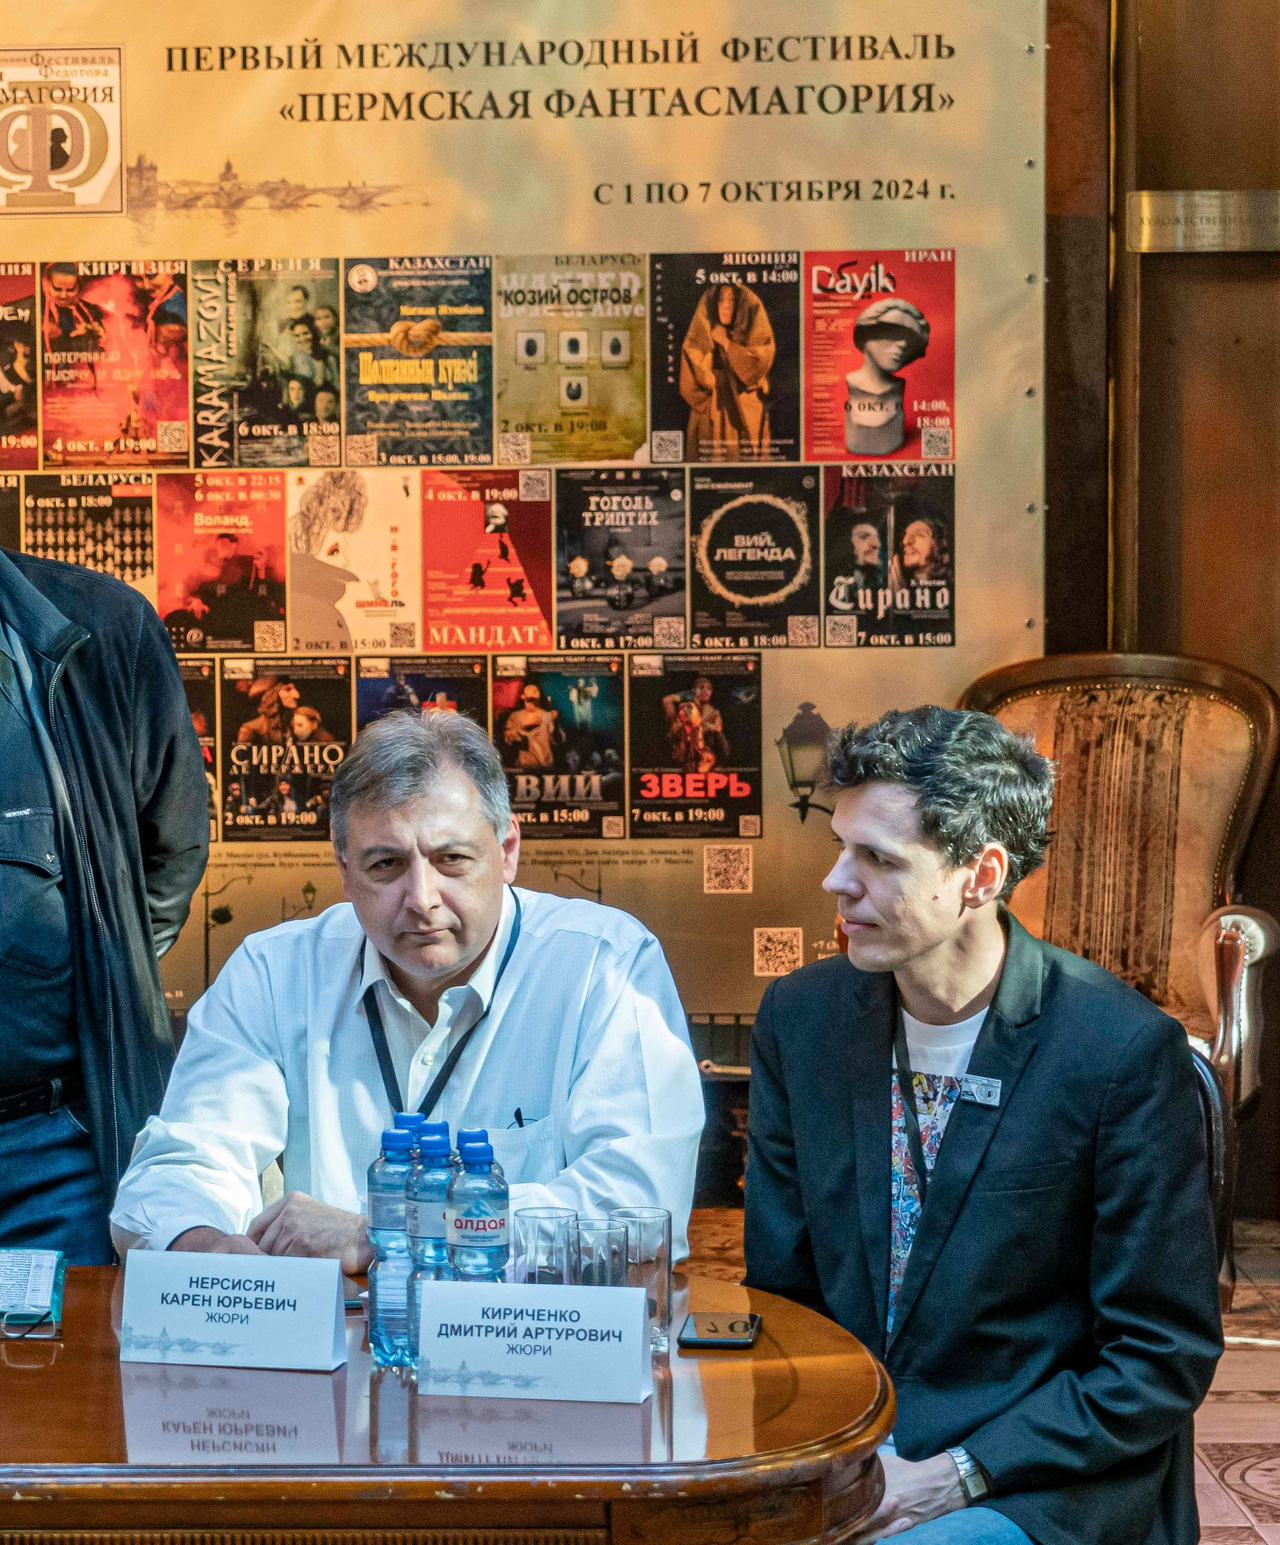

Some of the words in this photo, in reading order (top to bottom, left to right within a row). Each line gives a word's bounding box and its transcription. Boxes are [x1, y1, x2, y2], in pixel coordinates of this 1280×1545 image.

[165, 38, 323, 72] ПЕРВЫЙ
[336, 32, 700, 73] МЕЖДУНАРОДНЫЙ
[720, 33, 956, 64] ФЕСТИВАЛЬ
[279, 88, 532, 122] «ПЕРМСКАЯ
[544, 83, 955, 118] ФАНТАСМАГОРИЯ»
[594, 182, 613, 205] С
[624, 183, 634, 204] 1
[645, 182, 689, 203] ПО
[698, 182, 711, 203] 7
[720, 180, 861, 203] ОКТЯБРЯ
[871, 179, 930, 201] 2024
[388, 257, 491, 270] КАЗАХСТАН
[554, 254, 642, 266] БЕЛАРУСЬ
[722, 252, 798, 266] ЯПОНИЯ
[904, 249, 953, 263] ИРАН
[78, 260, 186, 276] КИРГИЗИЯ
[218, 258, 322, 273] СЕРБИЯ
[695, 269, 707, 285] 5
[709, 272, 743, 284] окт.
[746, 273, 756, 284] в
[762, 269, 798, 284] 14:00
[238, 421, 249, 437] 6
[251, 424, 284, 436] окт.
[288, 424, 299, 436] в
[302, 421, 340, 437] 18:00
[500, 420, 510, 434] 2
[515, 422, 548, 434] окт.
[554, 422, 563, 433] в
[569, 419, 607, 434] 19:00
[916, 416, 951, 429] 18:00
[0, 434, 38, 450] 19:00
[52, 437, 64, 453] 4
[66, 440, 101, 452] окт.
[119, 437, 157, 453] 19:00
[378, 452, 388, 465] 3
[841, 463, 954, 478] КАЗАХСТАН
[60, 473, 153, 487] БЕЛАРУСЬ
[194, 473, 204, 488] 5
[24, 494, 35, 509] 6
[81, 495, 113, 508] 18:00
[194, 488, 205, 503] 6
[424, 488, 435, 501] 4
[437, 490, 468, 501] окт.
[484, 488, 519, 500] 19:00
[589, 495, 655, 511] ГОГОЛЬ
[581, 510, 659, 527] ТРИПТИХ
[713, 547, 796, 562] ЛЕГЕНДА
[828, 576, 951, 620] Сирано
[293, 639, 301, 651] 2
[353, 638, 387, 650] 15:00
[429, 626, 539, 648] МАНДАТ
[559, 636, 567, 649] 1
[570, 638, 602, 649] окт.
[619, 636, 653, 649] 17:00
[692, 634, 702, 648] 5
[753, 635, 787, 648] 18:00
[857, 631, 867, 646] 7
[870, 634, 901, 646] окт.
[918, 631, 952, 646] 15:00
[230, 744, 345, 767] СИРАНО
[514, 770, 604, 803] ВИЙ
[640, 773, 752, 799] ЗВЕРЬ
[224, 811, 234, 826] 2
[235, 815, 266, 826] окт.
[280, 811, 318, 826] 19:00
[553, 809, 590, 823] 15:00
[632, 808, 640, 823] 7
[643, 812, 672, 823] окт.
[675, 812, 684, 823] в
[687, 808, 726, 823] 19:00
[189, 1276, 276, 1293] НЕРСИСЯН
[160, 1292, 212, 1308] КАРЕН
[217, 1295, 297, 1312] ЮРЬЕВИЧ
[205, 1311, 250, 1325] ЖЮРИ
[481, 1307, 581, 1324] КИРИЧЕНКО
[437, 1322, 518, 1340] ДМИТРИЙ
[522, 1325, 623, 1343] АРТУРОВИЧ
[506, 1343, 553, 1357] ЖЮРИ
